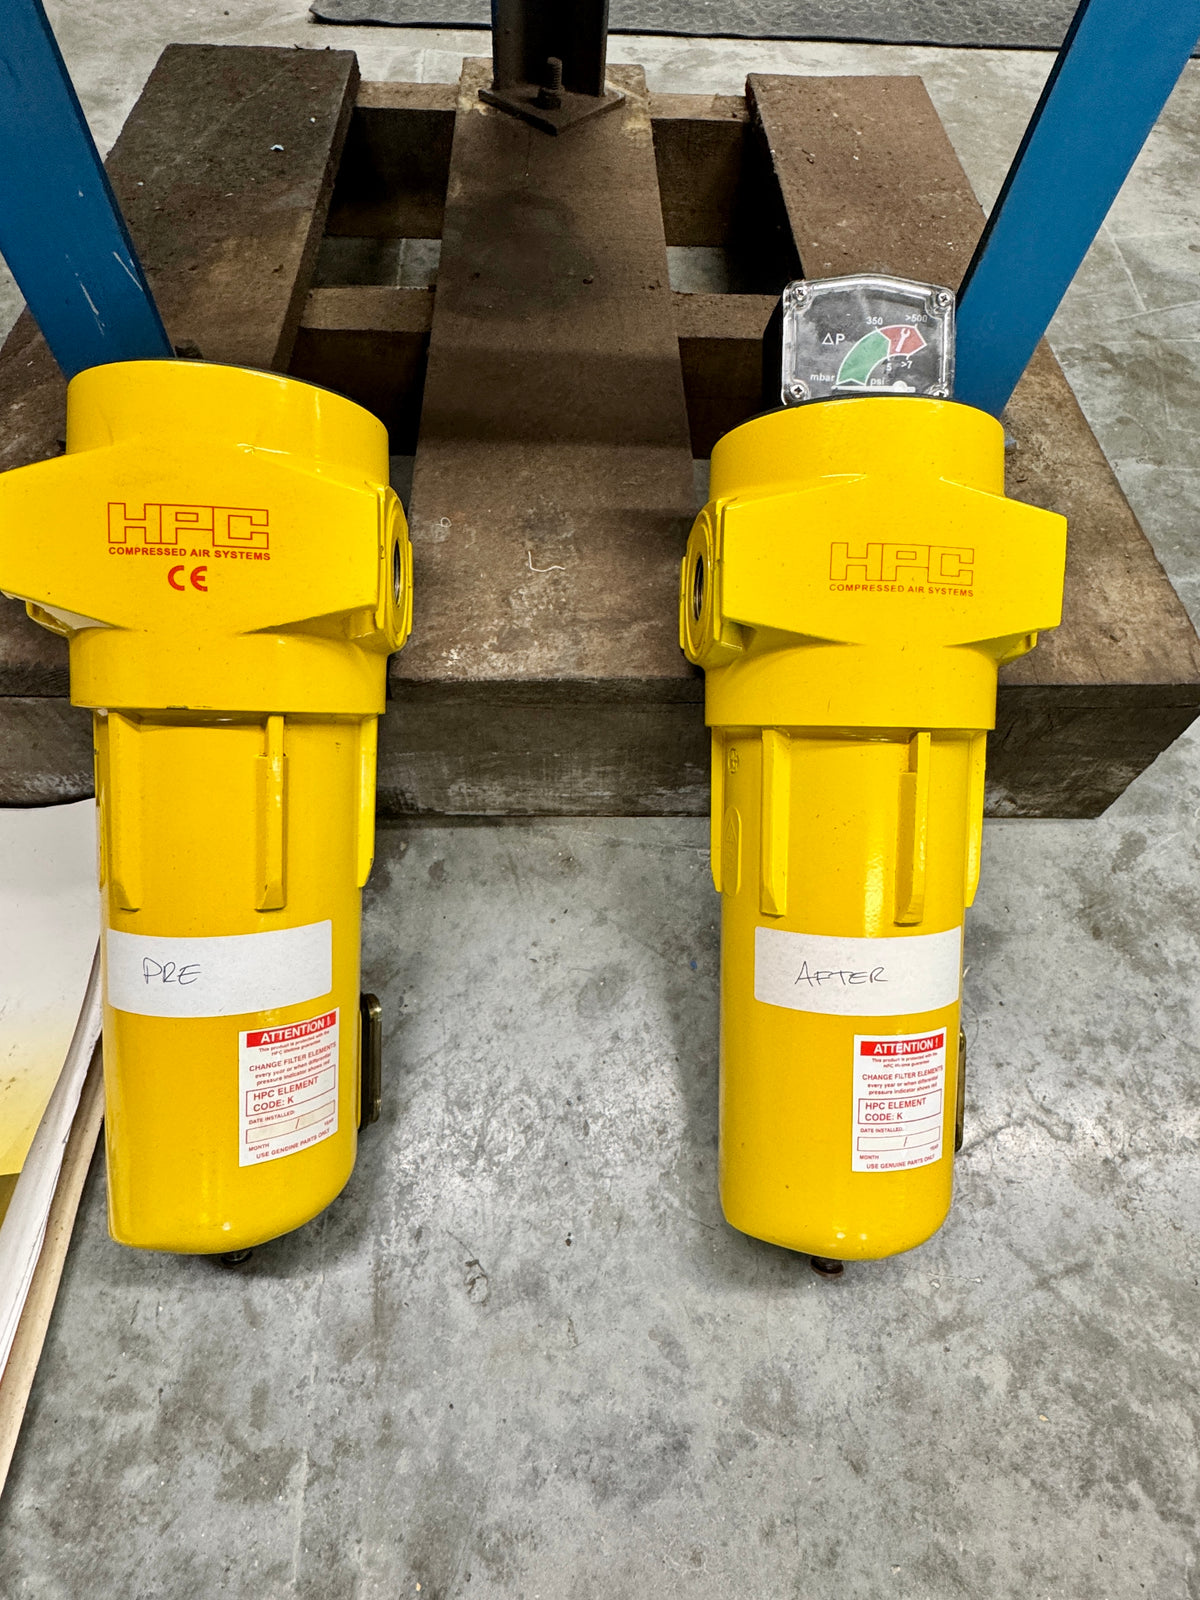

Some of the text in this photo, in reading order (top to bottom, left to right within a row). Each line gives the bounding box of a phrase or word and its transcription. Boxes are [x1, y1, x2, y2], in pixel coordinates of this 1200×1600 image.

[866, 316, 883, 326] 350
[905, 314, 928, 323] >500
[886, 362, 892, 371] 5
[901, 361, 913, 369] >7
[810, 373, 836, 382] mbar
[870, 378, 885, 387] psi
[107, 502, 269, 550] HPC
[108, 547, 271, 561] COMPRESSED AIR SYSTEMS
[829, 542, 975, 586] HPC
[167, 565, 208, 592] CE
[829, 583, 974, 597] COMPRESSED AIR SYSTEMS
[142, 956, 202, 985] PRE
[794, 960, 889, 988] AFTER
[260, 1017, 325, 1044] ATTENTION
[873, 1039, 934, 1054] ATTENTION
[249, 1041, 336, 1072] CHANGE FILTER ELEMENTS
[255, 1070, 271, 1079] every
[273, 1068, 285, 1077] year
[293, 1061, 307, 1070] when
[256, 1076, 282, 1087] pressure
[284, 1068, 306, 1079] indicator
[308, 1063, 322, 1072] shows
[894, 1071, 916, 1080] FILTER
[918, 1065, 943, 1077] ELEMENTS
[253, 1075, 319, 1101] HPC ELEMENT
[253, 1096, 294, 1112] CODE: K
[865, 1097, 926, 1110] HPC ELEMENT
[865, 1113, 894, 1121] CODE:
[249, 1143, 269, 1151] MONTH
[256, 1151, 269, 1159] USE
[300, 1135, 317, 1146] PARTS
[318, 1128, 330, 1138] ONLY
[880, 1161, 906, 1169] GENUINE
[907, 1157, 923, 1165] PARTS
